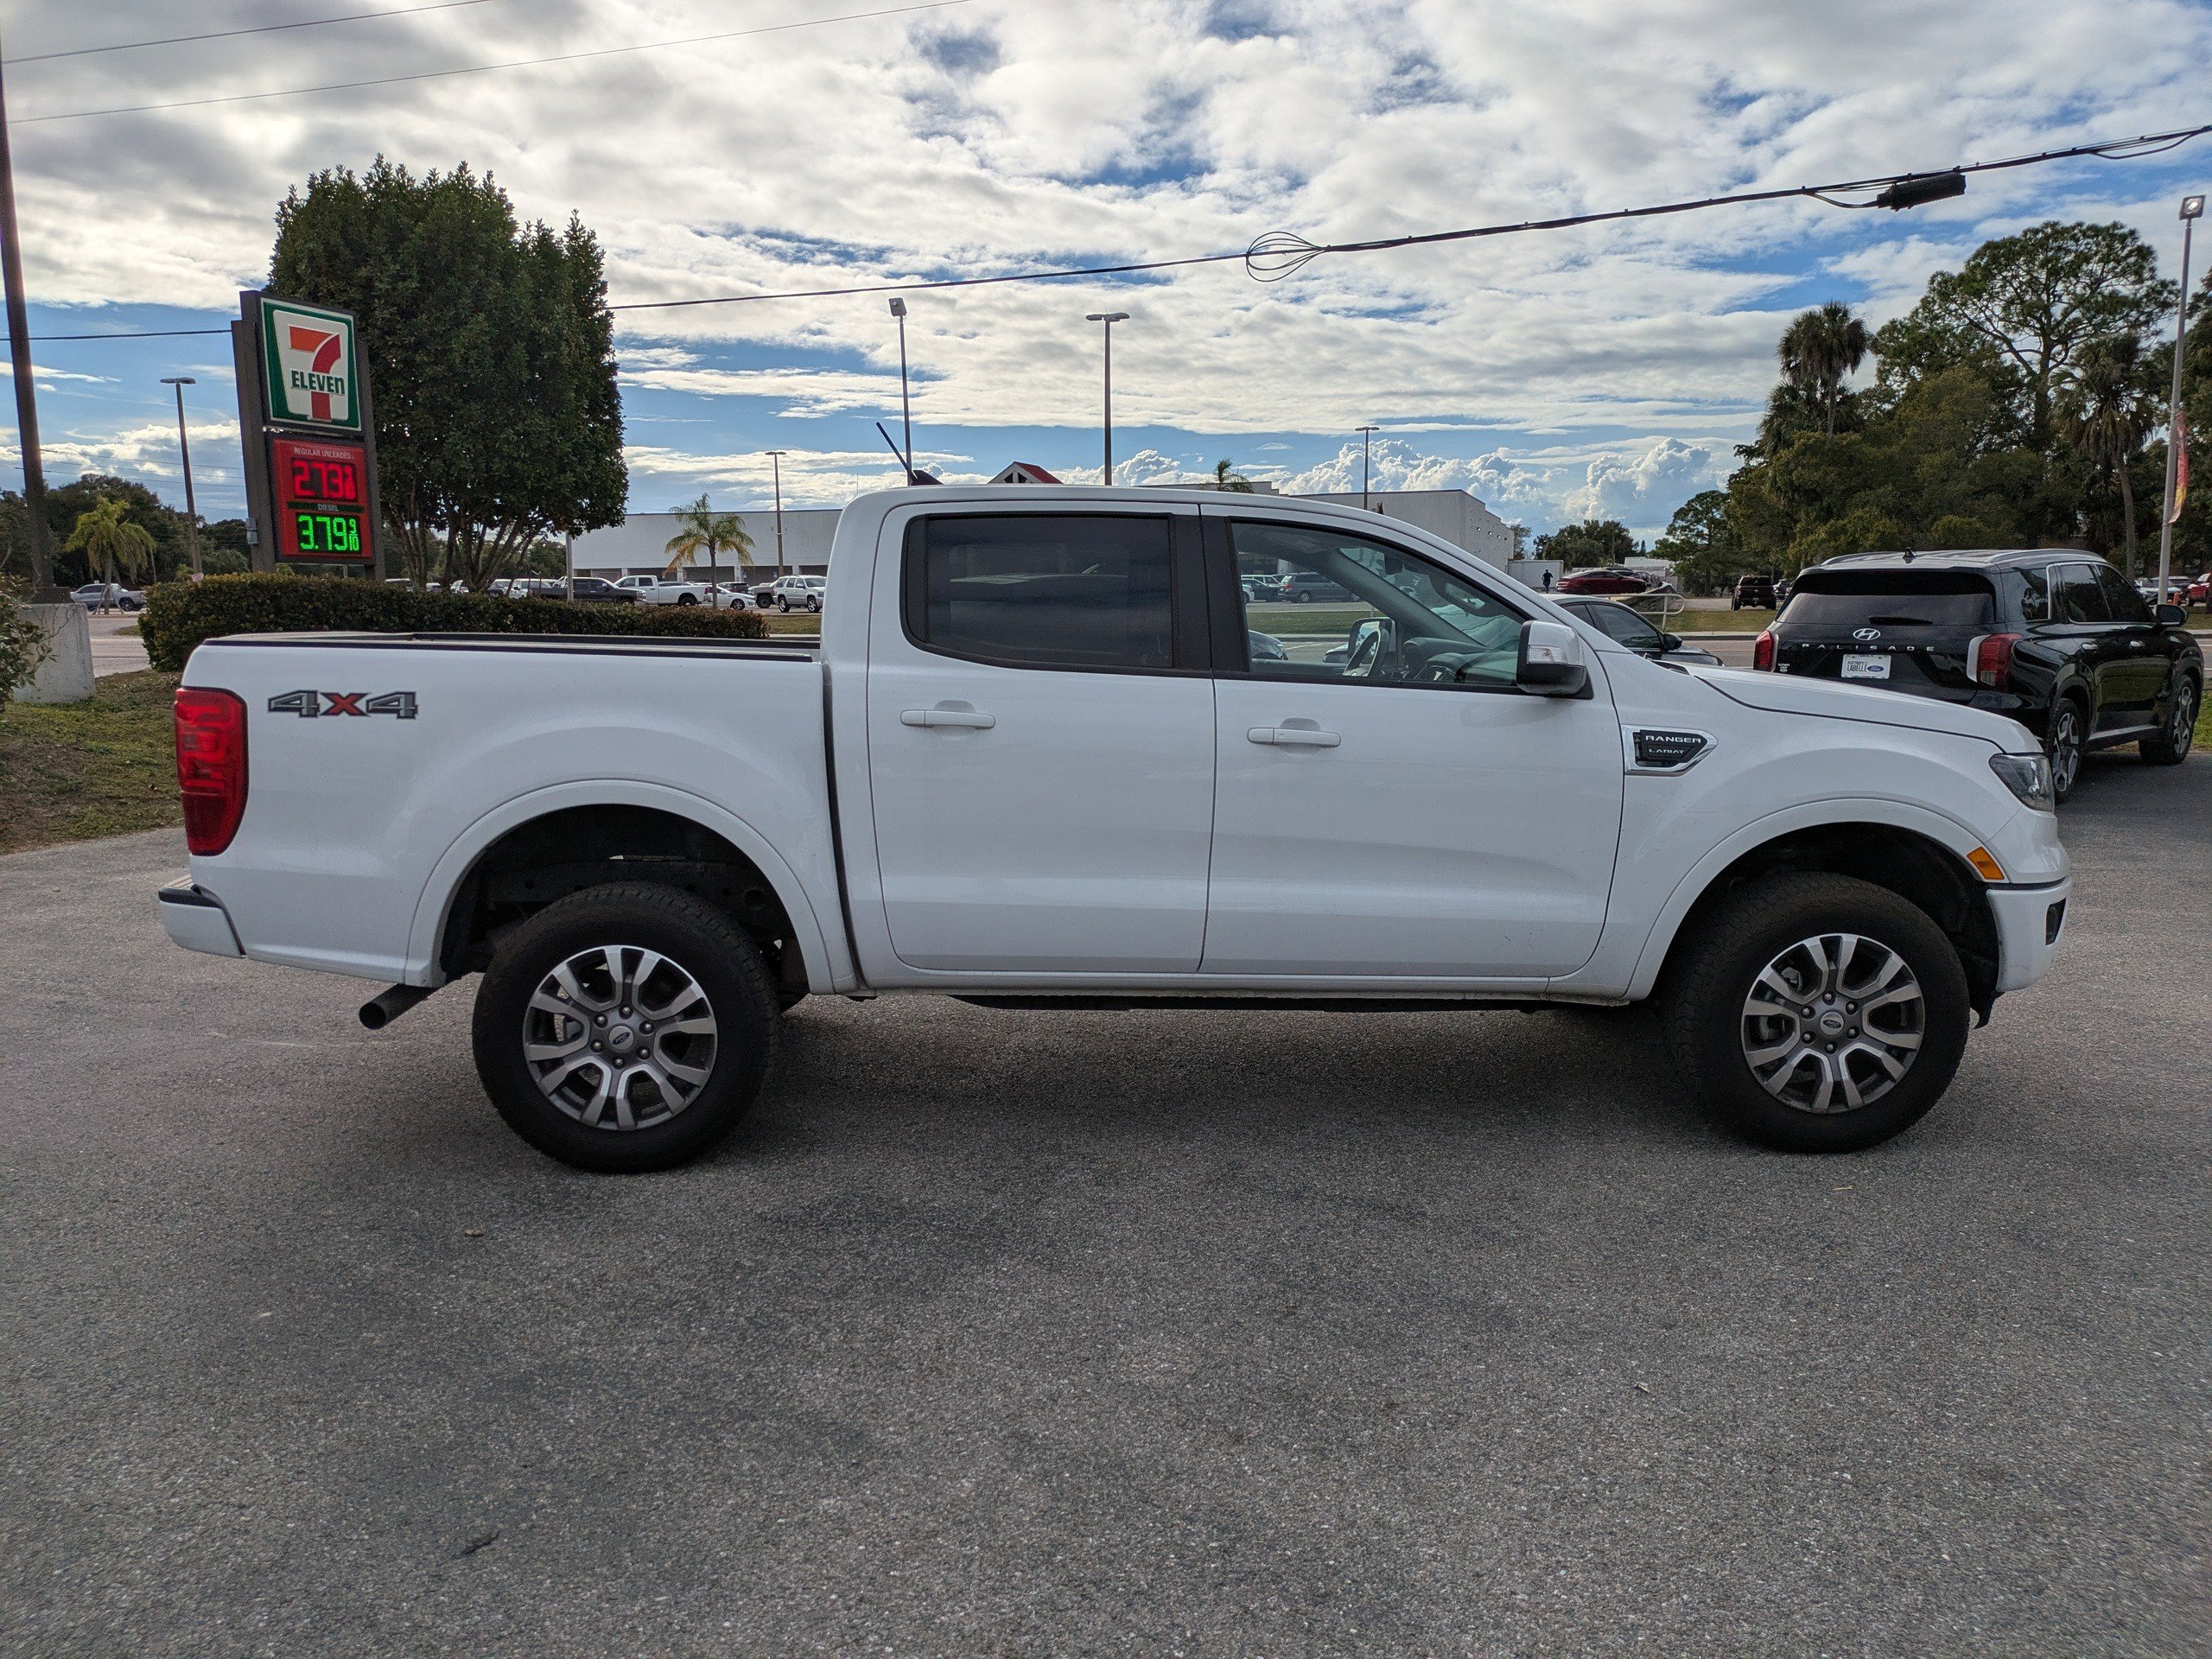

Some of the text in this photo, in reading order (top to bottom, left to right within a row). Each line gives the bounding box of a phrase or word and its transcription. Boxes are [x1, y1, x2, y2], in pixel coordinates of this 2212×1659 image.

[289, 326, 341, 420] 7
[294, 447, 352, 460] REGULAR UNLEADED
[298, 515, 348, 550] 3.79
[1802, 643, 1935, 652] PALISADE
[1645, 734, 1701, 744] RANGER
